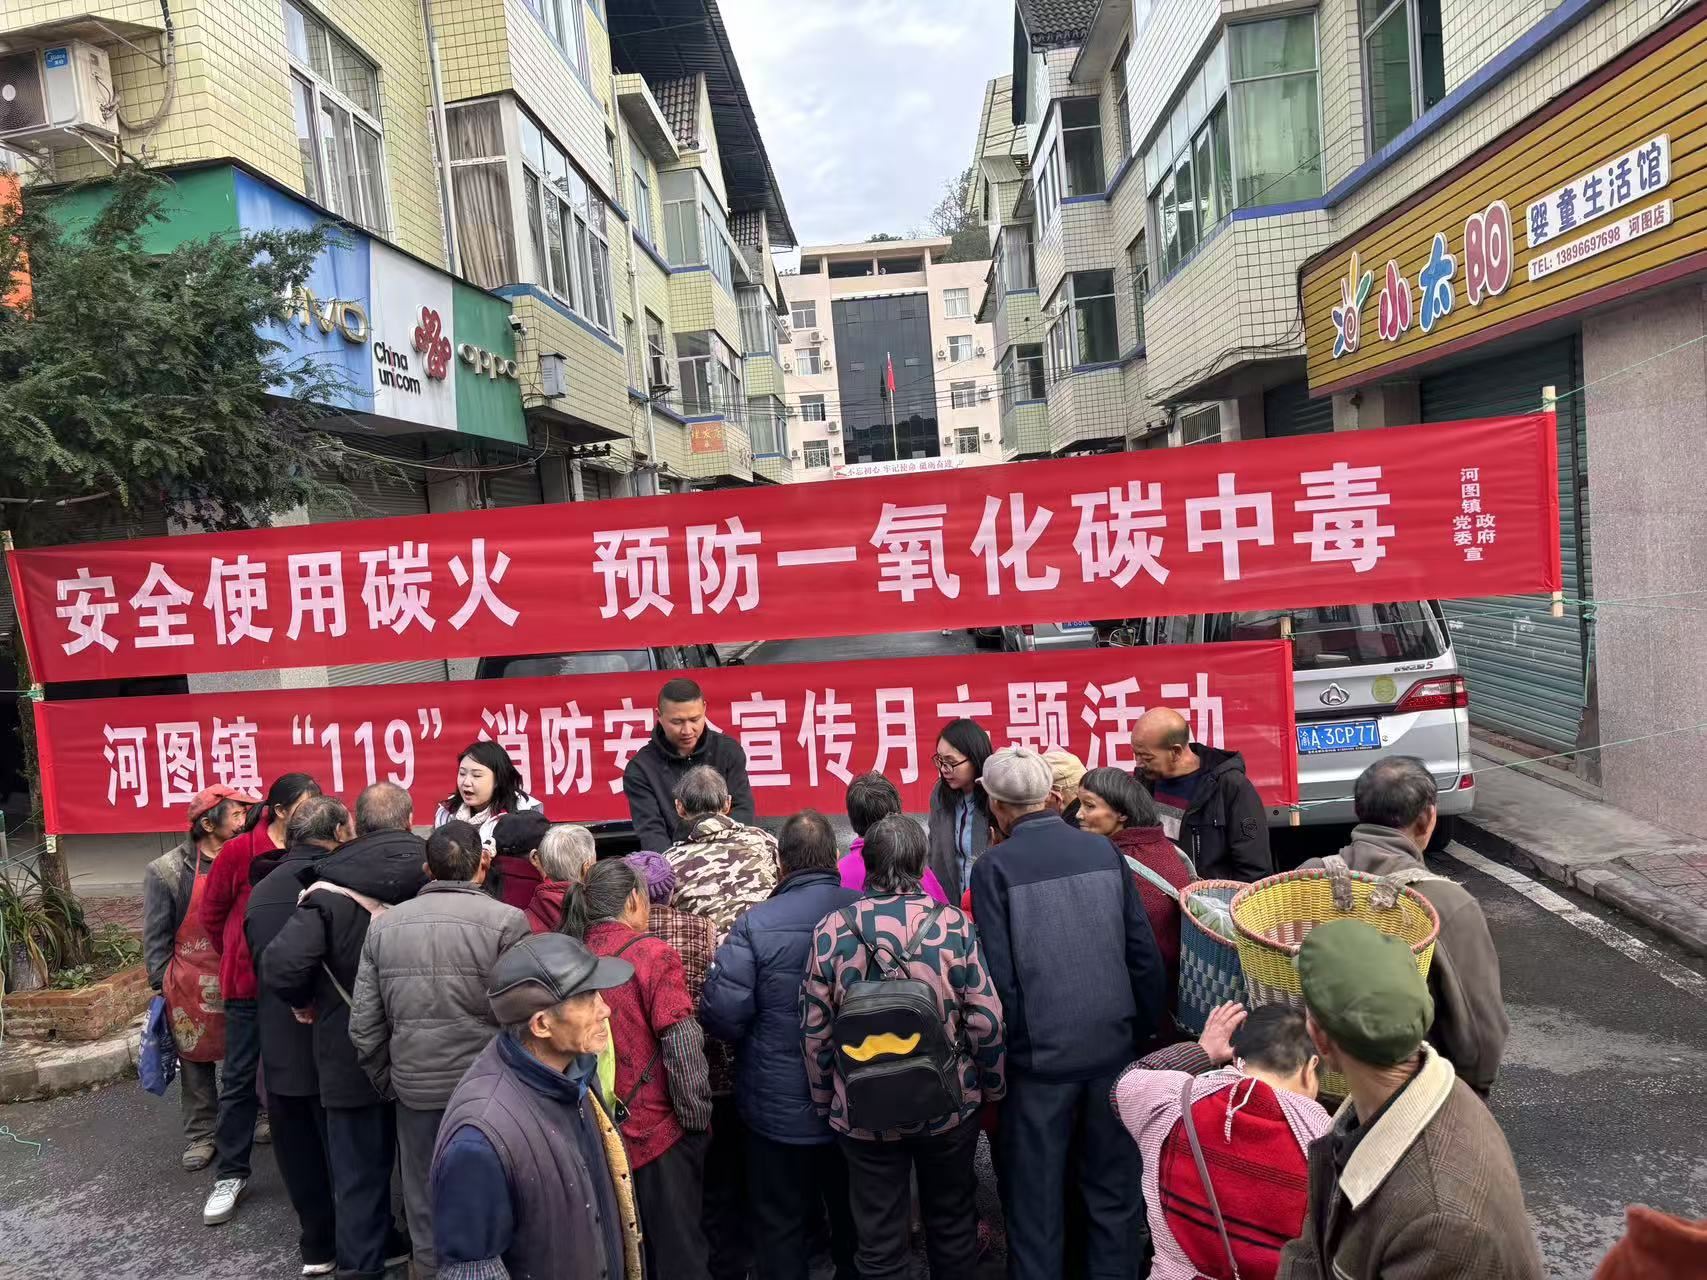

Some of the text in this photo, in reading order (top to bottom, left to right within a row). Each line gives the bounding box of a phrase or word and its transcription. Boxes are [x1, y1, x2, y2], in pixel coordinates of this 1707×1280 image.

[1530, 141, 1662, 245] 婴童生活馆
[1531, 204, 1665, 276] TEL: 13896697698 河图店
[1378, 200, 1514, 342] 小太阳
[373, 341, 409, 371] China
[378, 368, 421, 395] unicom
[1460, 467, 1481, 513] 河图镇
[1453, 515, 1473, 546] 党委
[1476, 513, 1496, 544] 政府
[56, 462, 1396, 656] 安全使用碳火 预防一氧化碳中毒
[1463, 546, 1484, 562] 宣
[103, 716, 263, 808] 河图镇
[477, 673, 1224, 796] 消防安宣传月题活动
